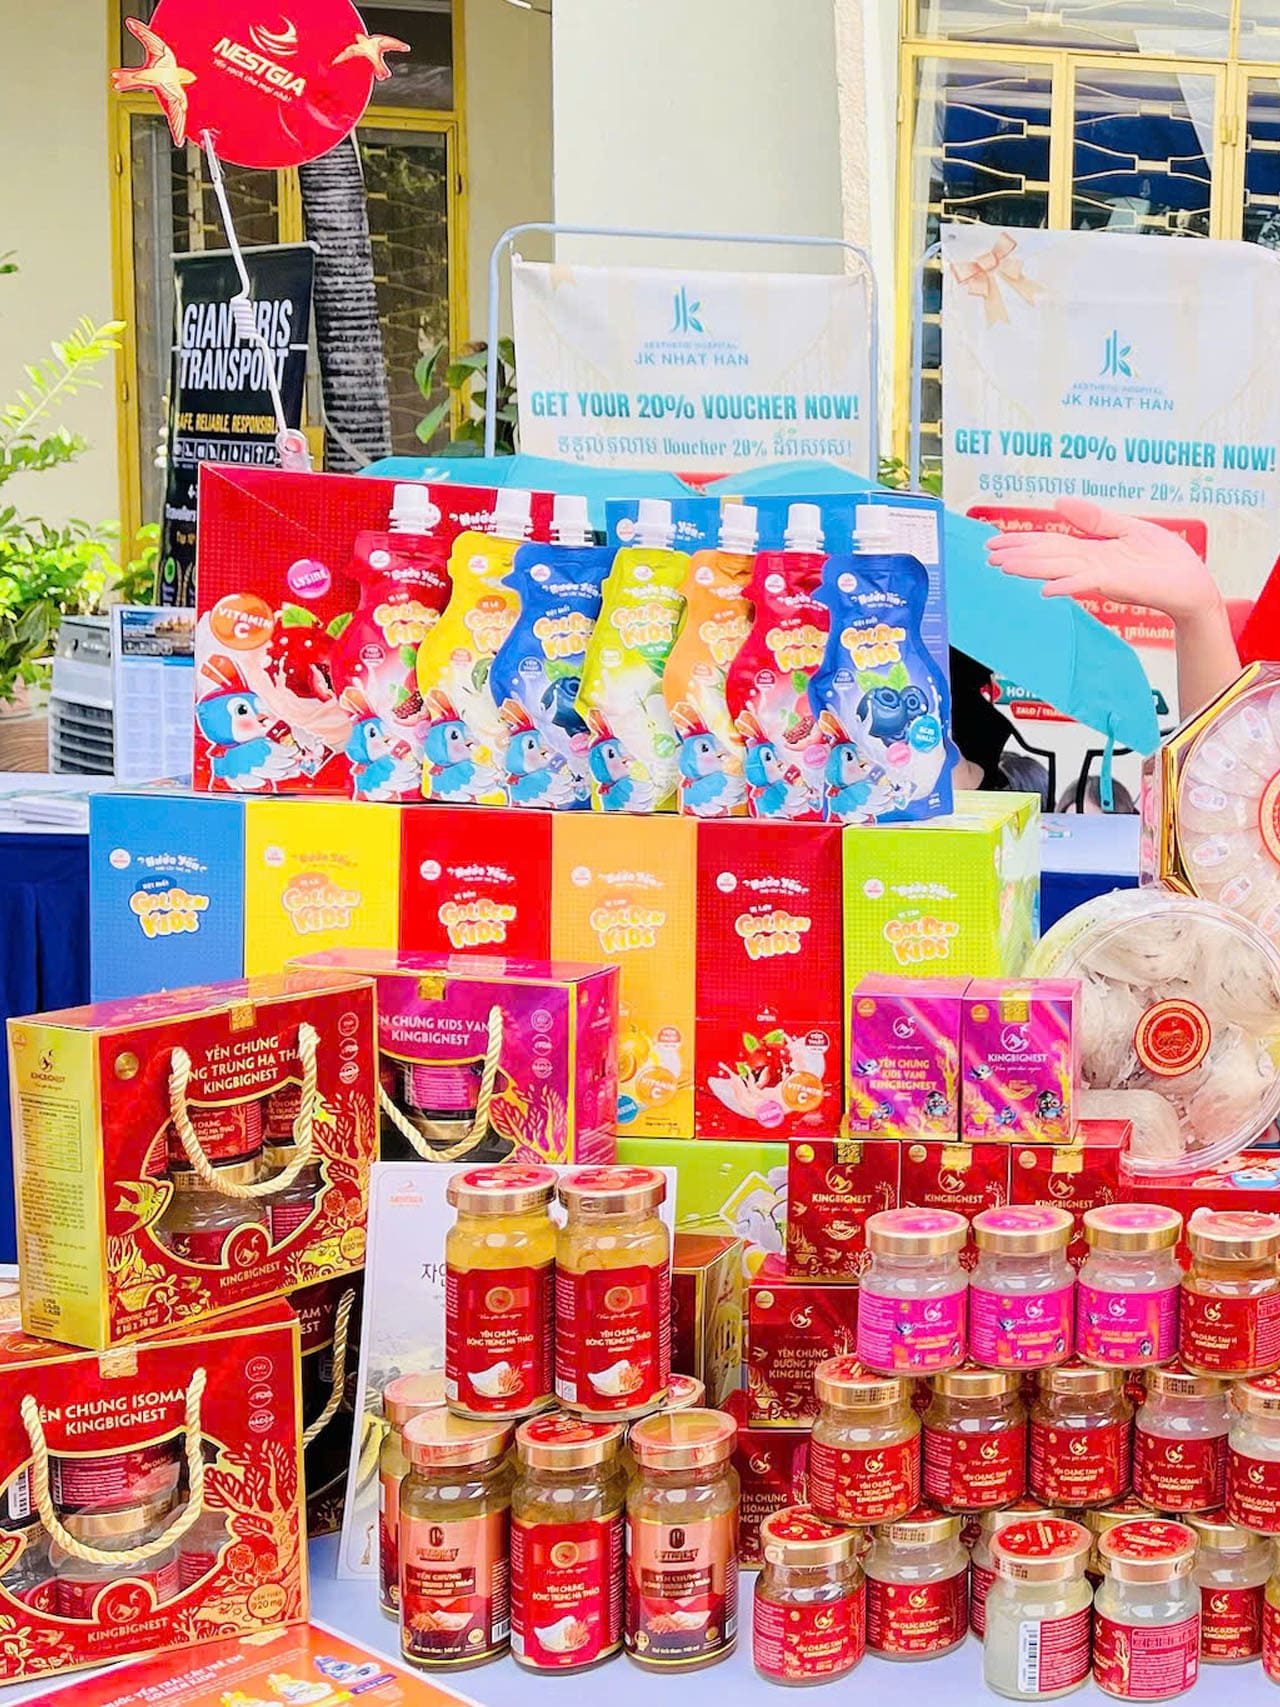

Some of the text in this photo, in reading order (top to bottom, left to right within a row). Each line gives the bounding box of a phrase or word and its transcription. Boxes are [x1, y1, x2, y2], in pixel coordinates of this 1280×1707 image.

[212, 36, 308, 97] NESTGIA
[634, 351, 749, 367] JK NHAT HAN
[180, 348, 289, 392] TRANSPORT
[531, 391, 860, 421] GET YOUR 20% VOUCHER NOW!
[1062, 394, 1174, 411] JK NHAT HAN
[663, 432, 767, 457] Voucher 20%
[955, 428, 1277, 472] GET YOUR 20% VOUCHER NOW!
[1082, 474, 1183, 502] Voucher 20%
[218, 606, 275, 629] VITAMIN
[233, 622, 250, 639] C
[392, 1015, 463, 1031] CHƯNG KIDS
[233, 1036, 279, 1056] CHƯNG
[391, 1030, 470, 1046] KINGBIGNEST
[257, 1053, 276, 1068] HẠ
[987, 1053, 1049, 1063] KINGBIGNEST
[203, 1077, 279, 1105] KINGBIGNEST
[869, 1080, 937, 1091] KINGBIGNEST
[797, 1091, 809, 1104] C
[811, 1193, 872, 1204] KINGBIGNEST
[925, 1193, 983, 1204] KINGBIGNEST
[218, 1261, 281, 1288] KINGBIGNEST
[65, 1398, 127, 1422] CHƯNG
[65, 1407, 167, 1436] KINGBIGNEST
[755, 1492, 787, 1503] CHƯNG
[87, 1617, 169, 1643] KINGBIGNEST
